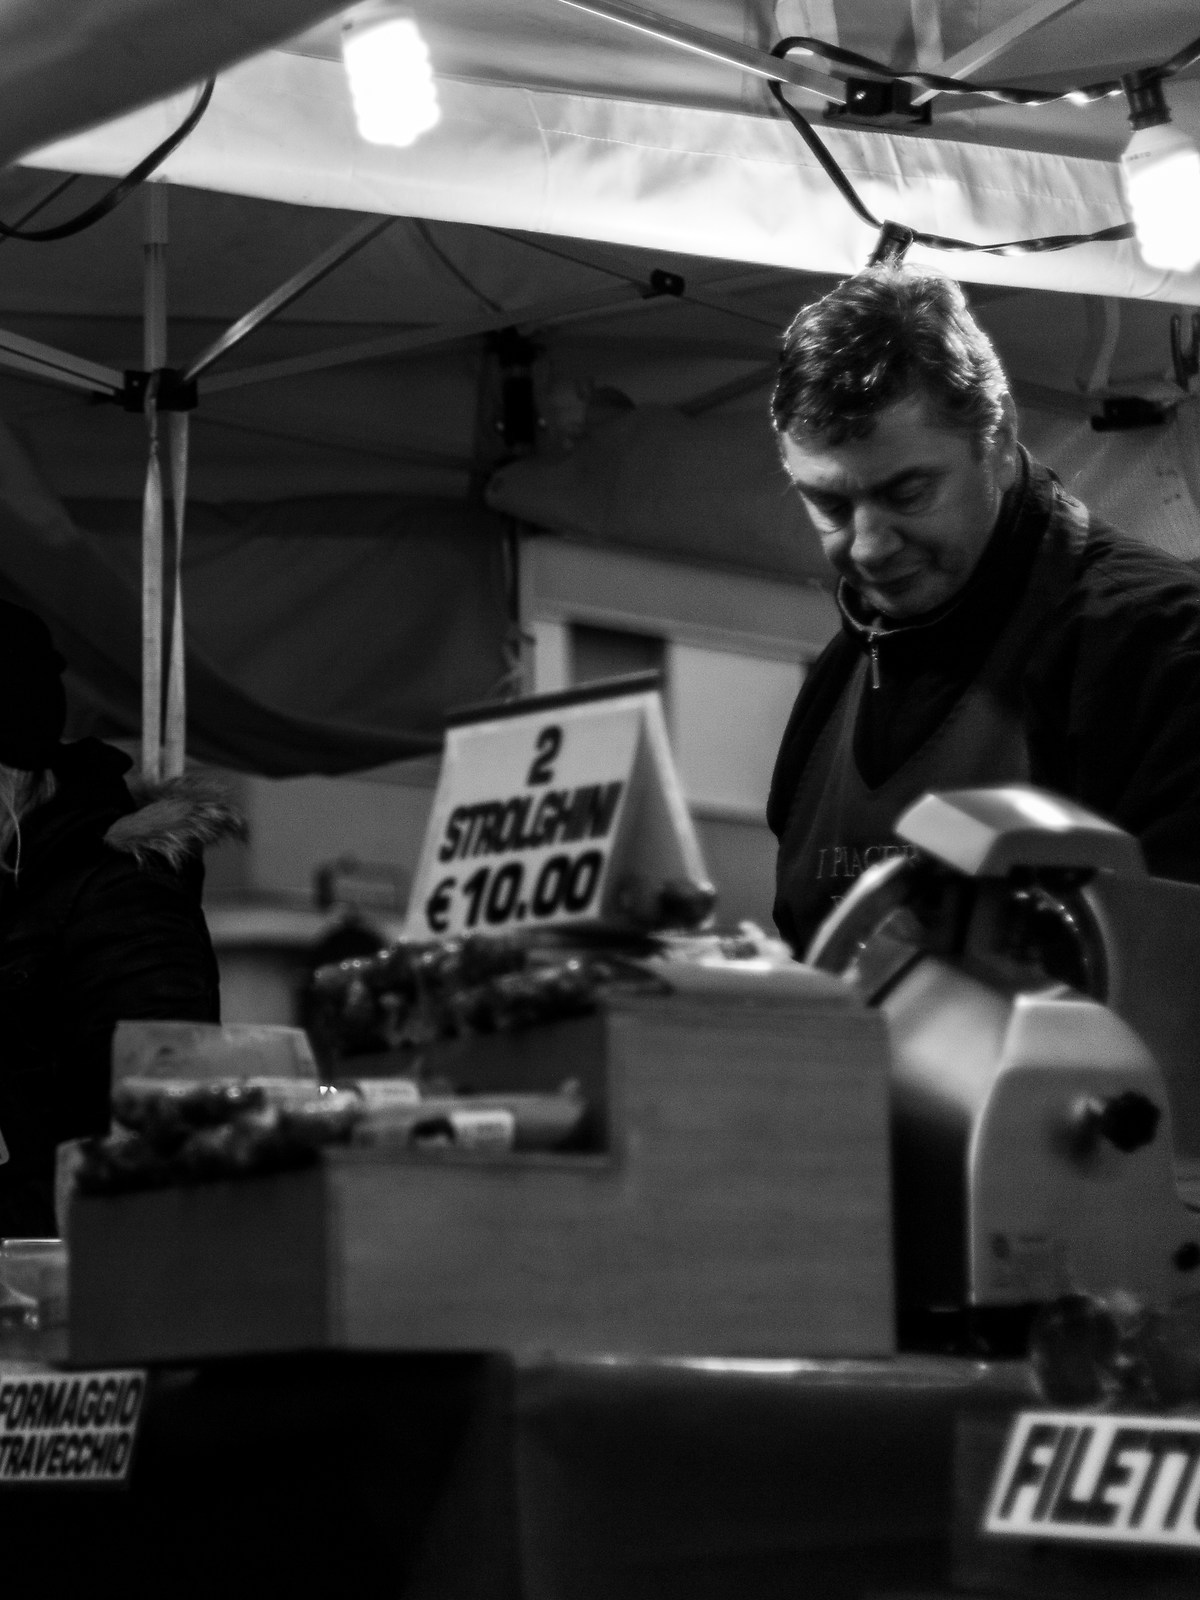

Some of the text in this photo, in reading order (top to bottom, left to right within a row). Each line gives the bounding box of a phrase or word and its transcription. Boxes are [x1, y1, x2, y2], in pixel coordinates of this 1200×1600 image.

[526, 725, 563, 787] 2
[439, 780, 624, 863] STROLGHINI
[997, 1423, 1200, 1534] FILETT
